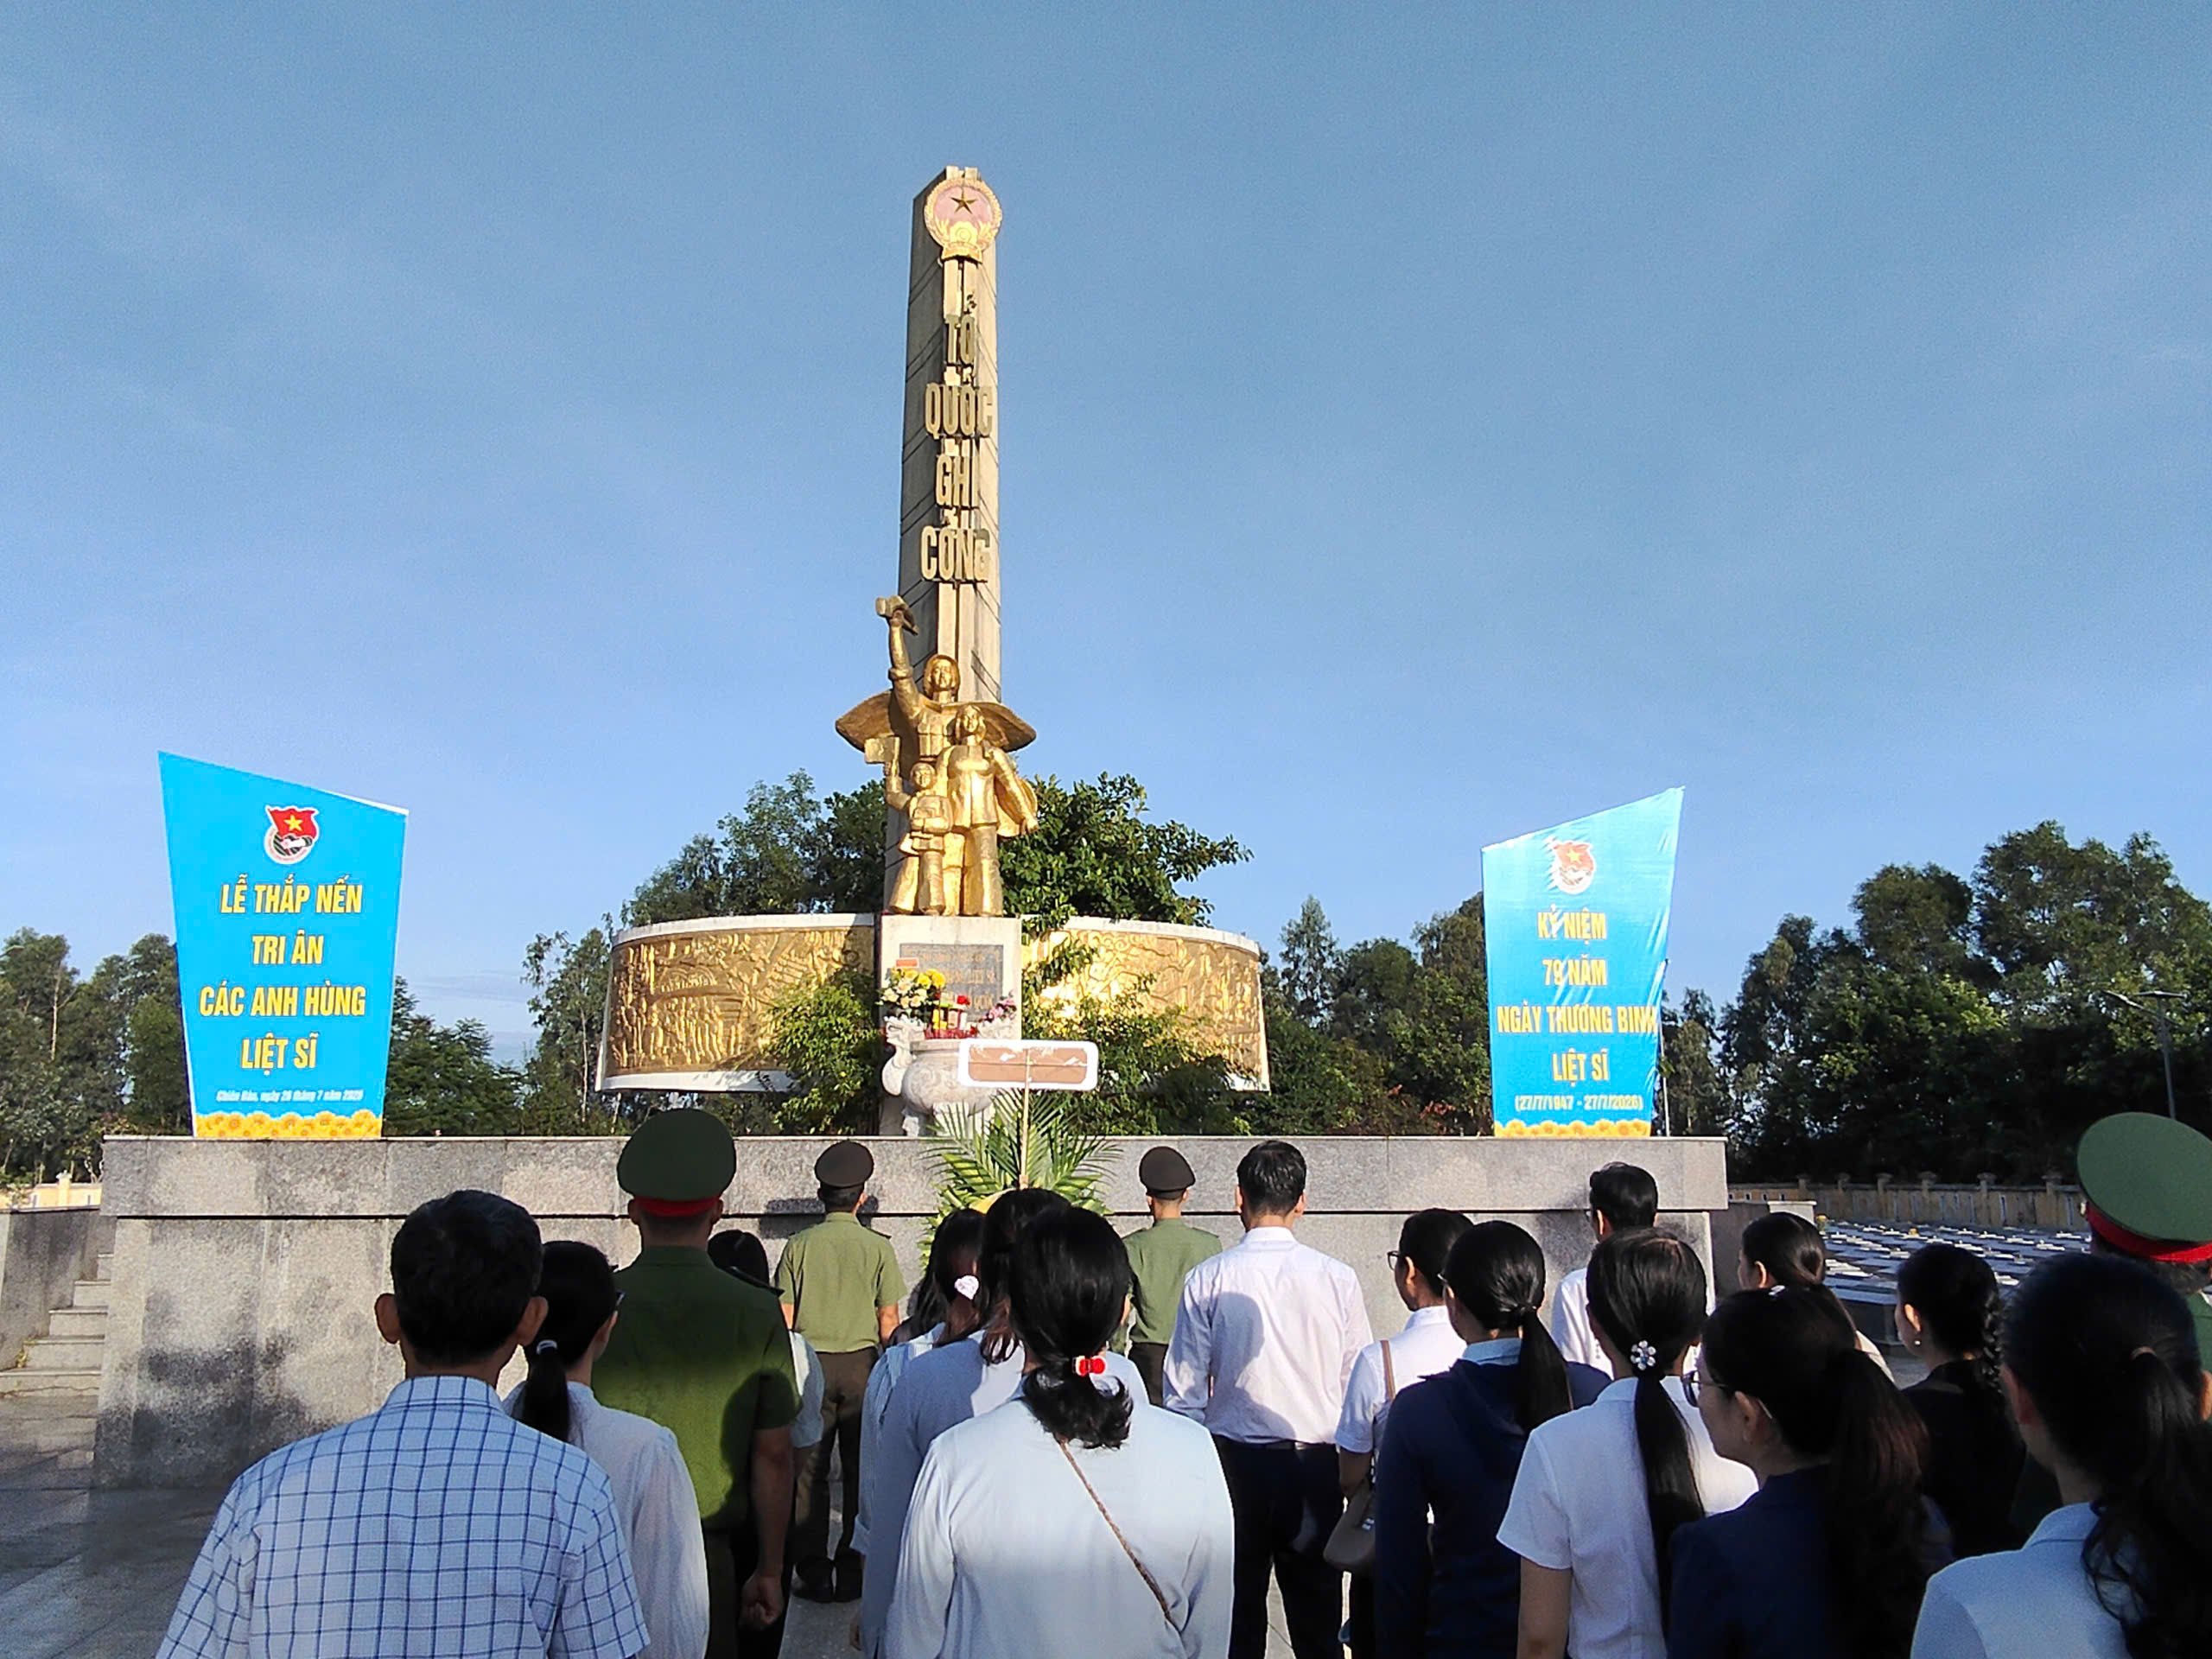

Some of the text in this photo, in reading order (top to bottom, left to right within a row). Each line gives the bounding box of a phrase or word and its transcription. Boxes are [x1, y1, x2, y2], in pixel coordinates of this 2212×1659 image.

[936, 454, 980, 507] GHI
[219, 873, 363, 914] LỄ THẮP NẾN
[1564, 907, 1606, 945] NIỆM
[251, 928, 324, 965] TRI ÂN
[1542, 954, 1607, 986] 79 NĂM
[199, 979, 365, 1017] CÁC ANH HÙNG
[1497, 1000, 1541, 1033] NGÀY
[1546, 1005, 1613, 1033] THƯƠNG
[241, 1031, 319, 1077] LIỆT SĨ
[1551, 1048, 1610, 1088] LIỆT SĨ
[292, 1089, 316, 1103] tháng
[322, 1089, 342, 1103] năm
